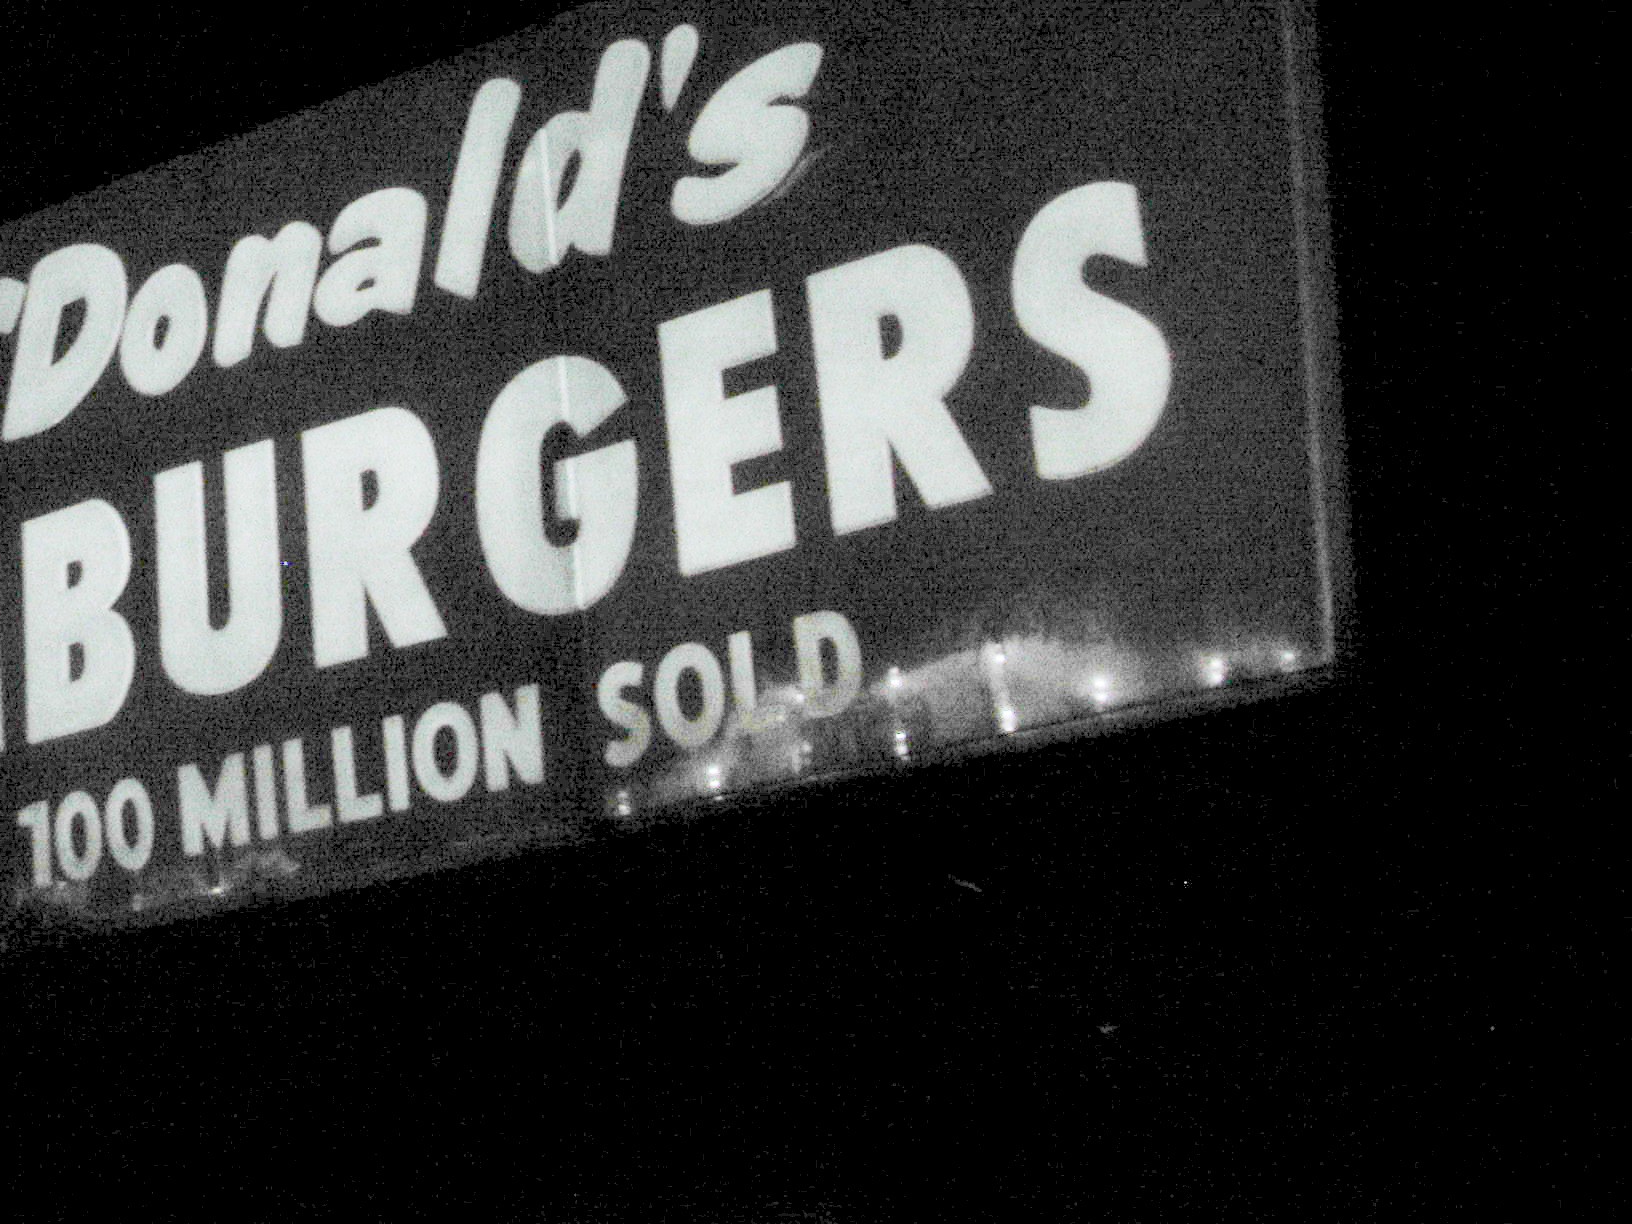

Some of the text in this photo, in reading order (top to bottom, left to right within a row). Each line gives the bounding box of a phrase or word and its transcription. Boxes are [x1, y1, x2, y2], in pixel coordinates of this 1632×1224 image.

[17, 777, 155, 888] 100
[177, 684, 545, 857] MILLION
[597, 610, 862, 768] SOLD
